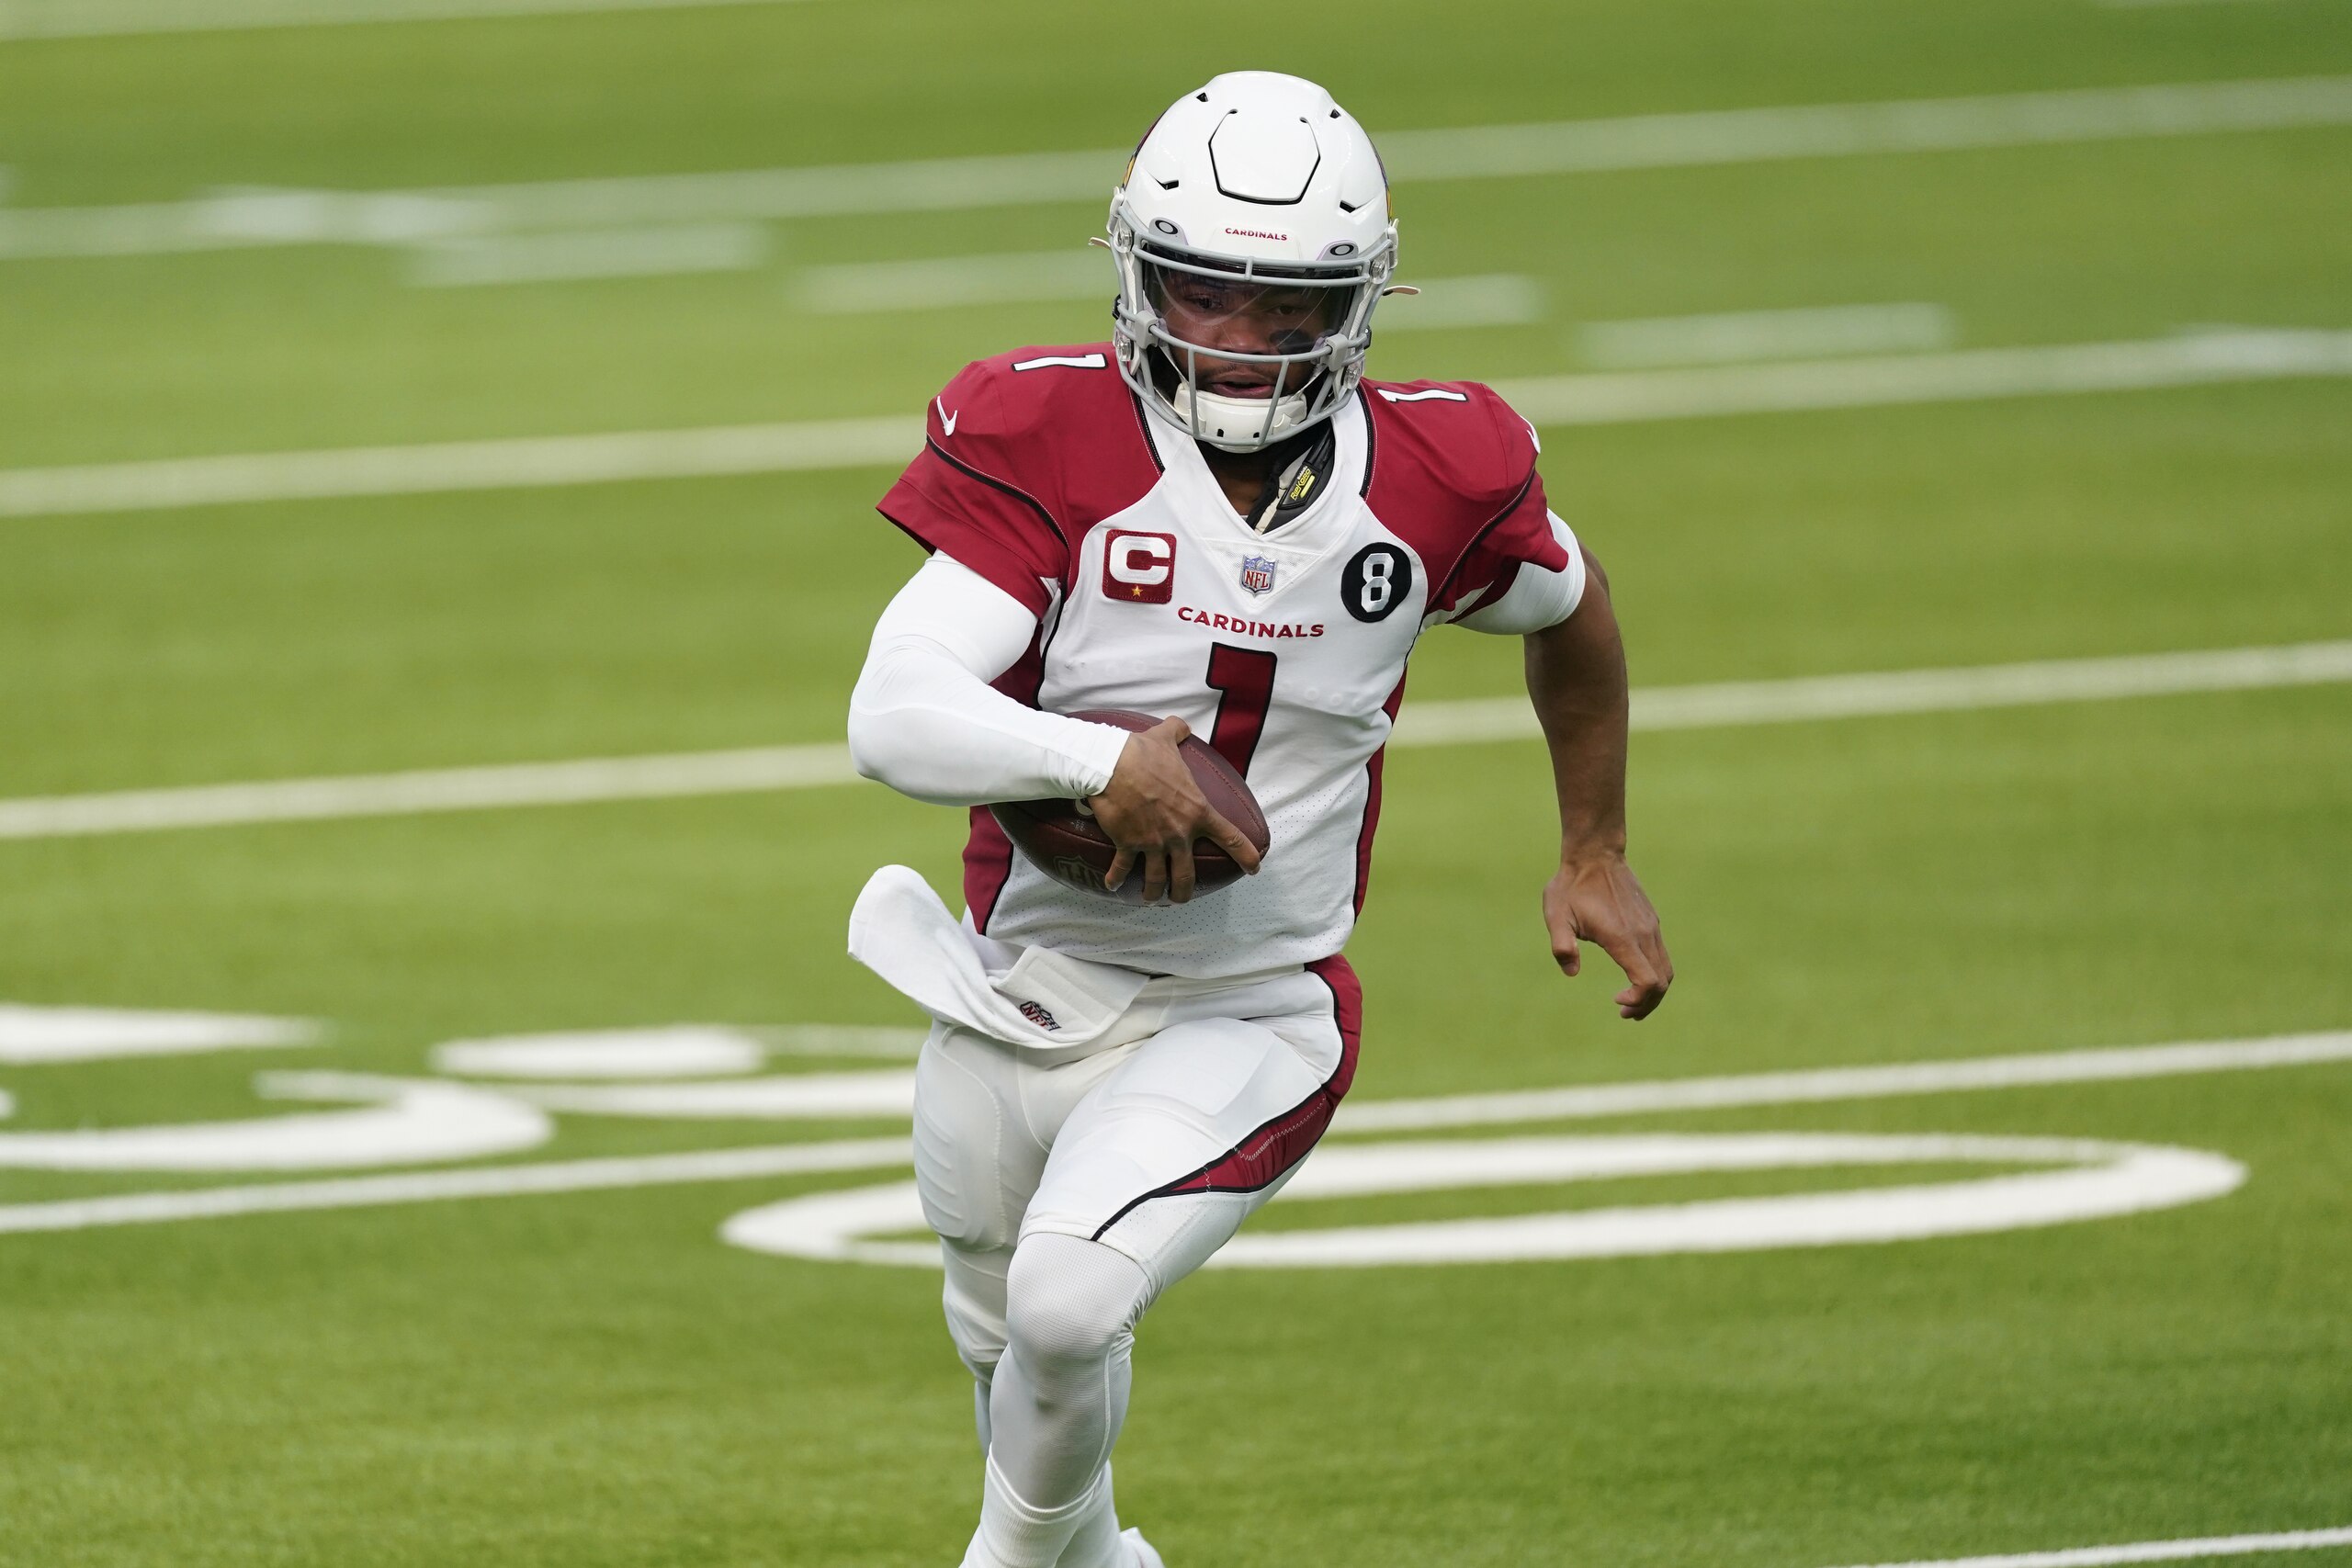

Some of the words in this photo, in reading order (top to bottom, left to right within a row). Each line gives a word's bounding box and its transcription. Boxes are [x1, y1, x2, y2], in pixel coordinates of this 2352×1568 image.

[1225, 228, 1288, 241] CARDINALS
[1109, 535, 1170, 584] C
[1244, 570, 1269, 590] NFL
[1361, 552, 1395, 613] 8
[1178, 606, 1325, 638] CARDINALS
[1205, 642, 1277, 781] 1
